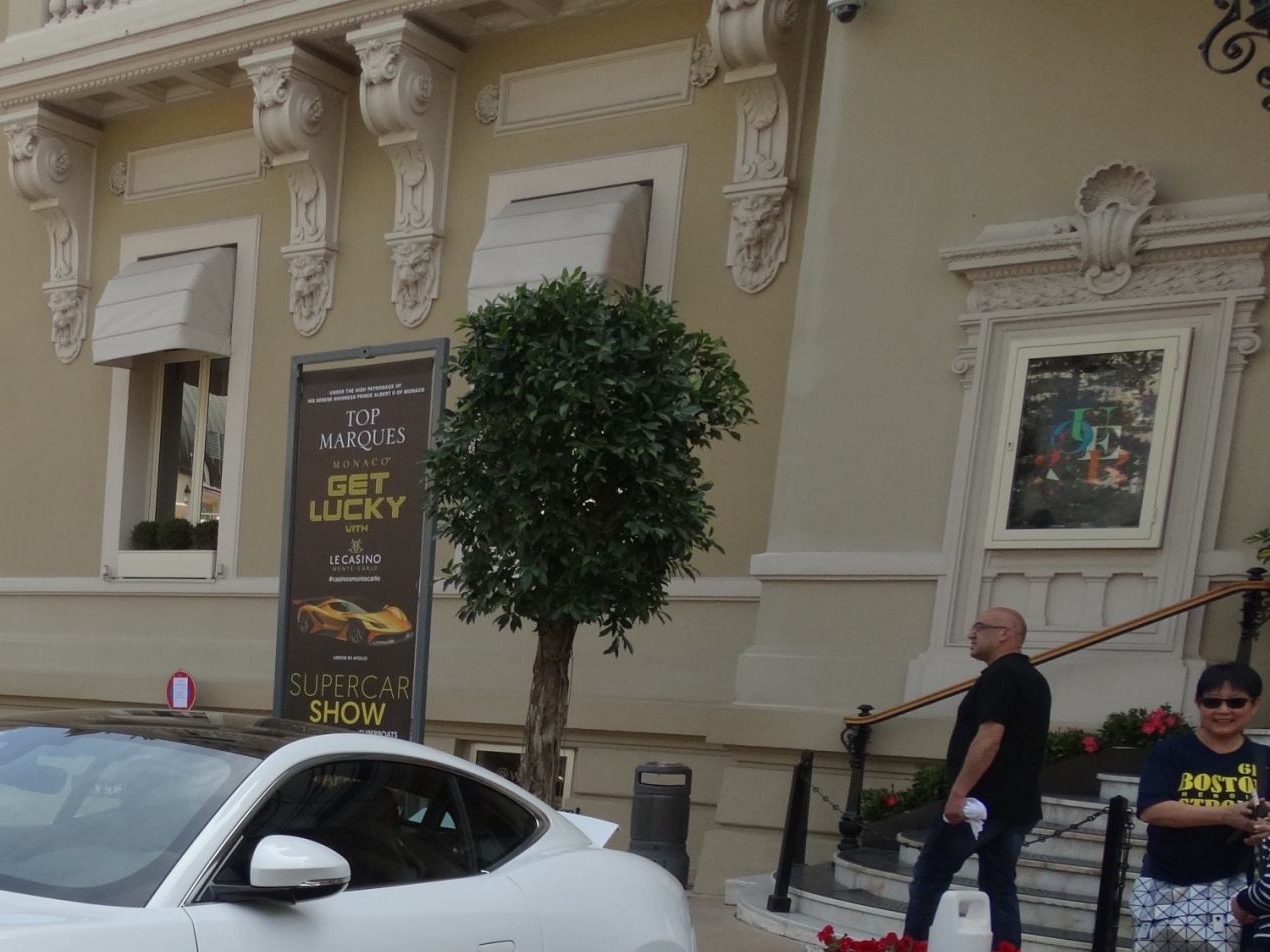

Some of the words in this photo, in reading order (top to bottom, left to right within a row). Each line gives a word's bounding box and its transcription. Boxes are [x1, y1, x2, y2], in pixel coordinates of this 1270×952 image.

[373, 390, 392, 398] ALBERT
[403, 387, 425, 395] MONACO
[345, 407, 381, 427] TOP
[319, 426, 406, 452] MARQUES
[327, 471, 390, 497] GET
[309, 495, 407, 522] LUCKY
[345, 524, 369, 533] WITH
[329, 555, 339, 565] LE
[341, 554, 382, 564] CASINO
[289, 672, 410, 700] SUPERCAR
[309, 699, 386, 726] SHOW
